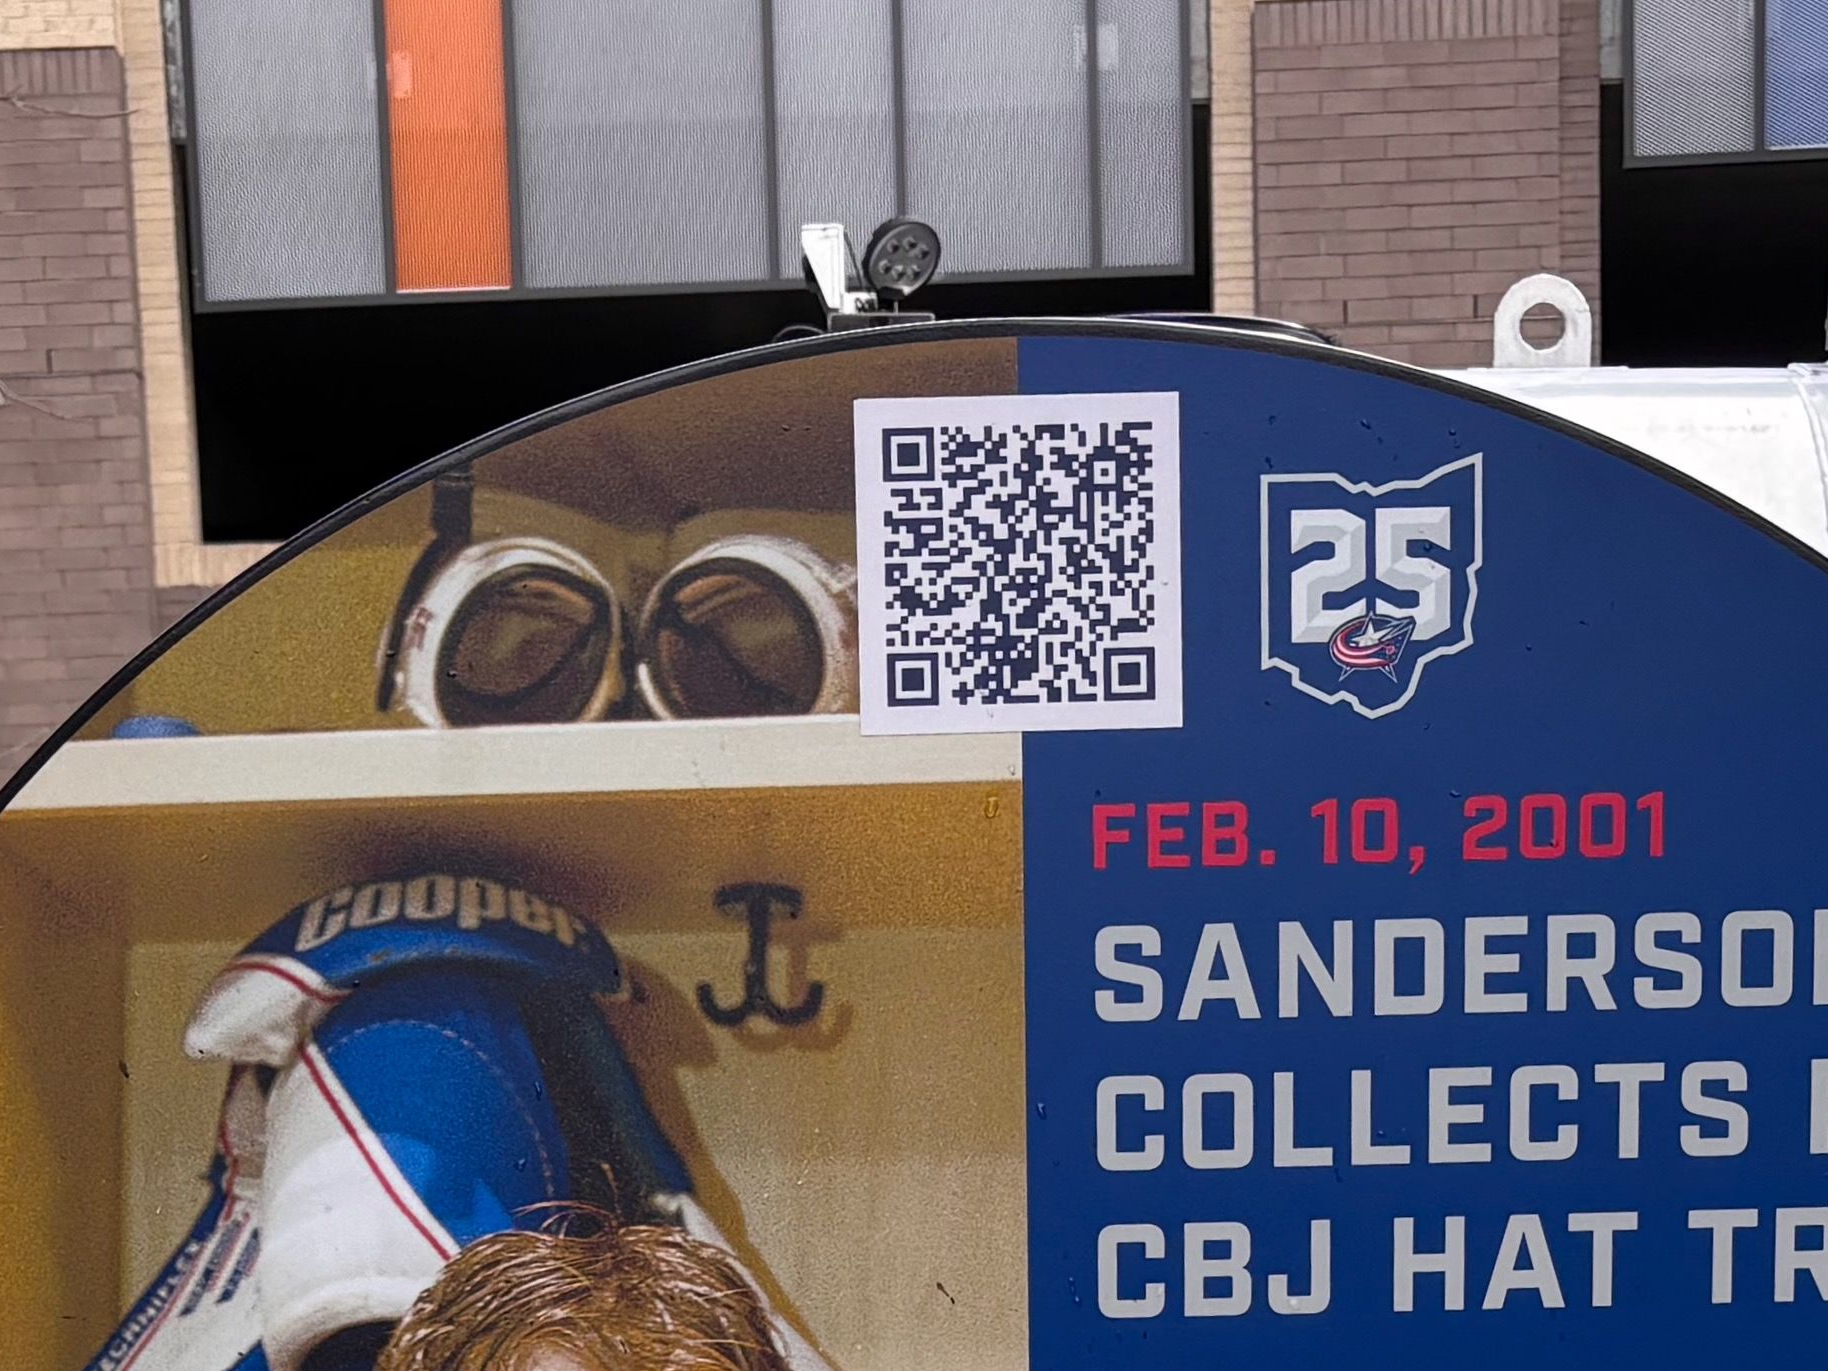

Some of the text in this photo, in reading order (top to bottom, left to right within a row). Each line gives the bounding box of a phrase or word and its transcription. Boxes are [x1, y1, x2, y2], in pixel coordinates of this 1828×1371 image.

[1289, 505, 1452, 645] 25
[1093, 792, 1665, 874] FEB. 10, 2001
[294, 874, 587, 952] Cooper
[1097, 1061, 1749, 1171] COLLECTS
[1098, 1220, 1331, 1319] CBJ
[1394, 1212, 1638, 1312] HAT
